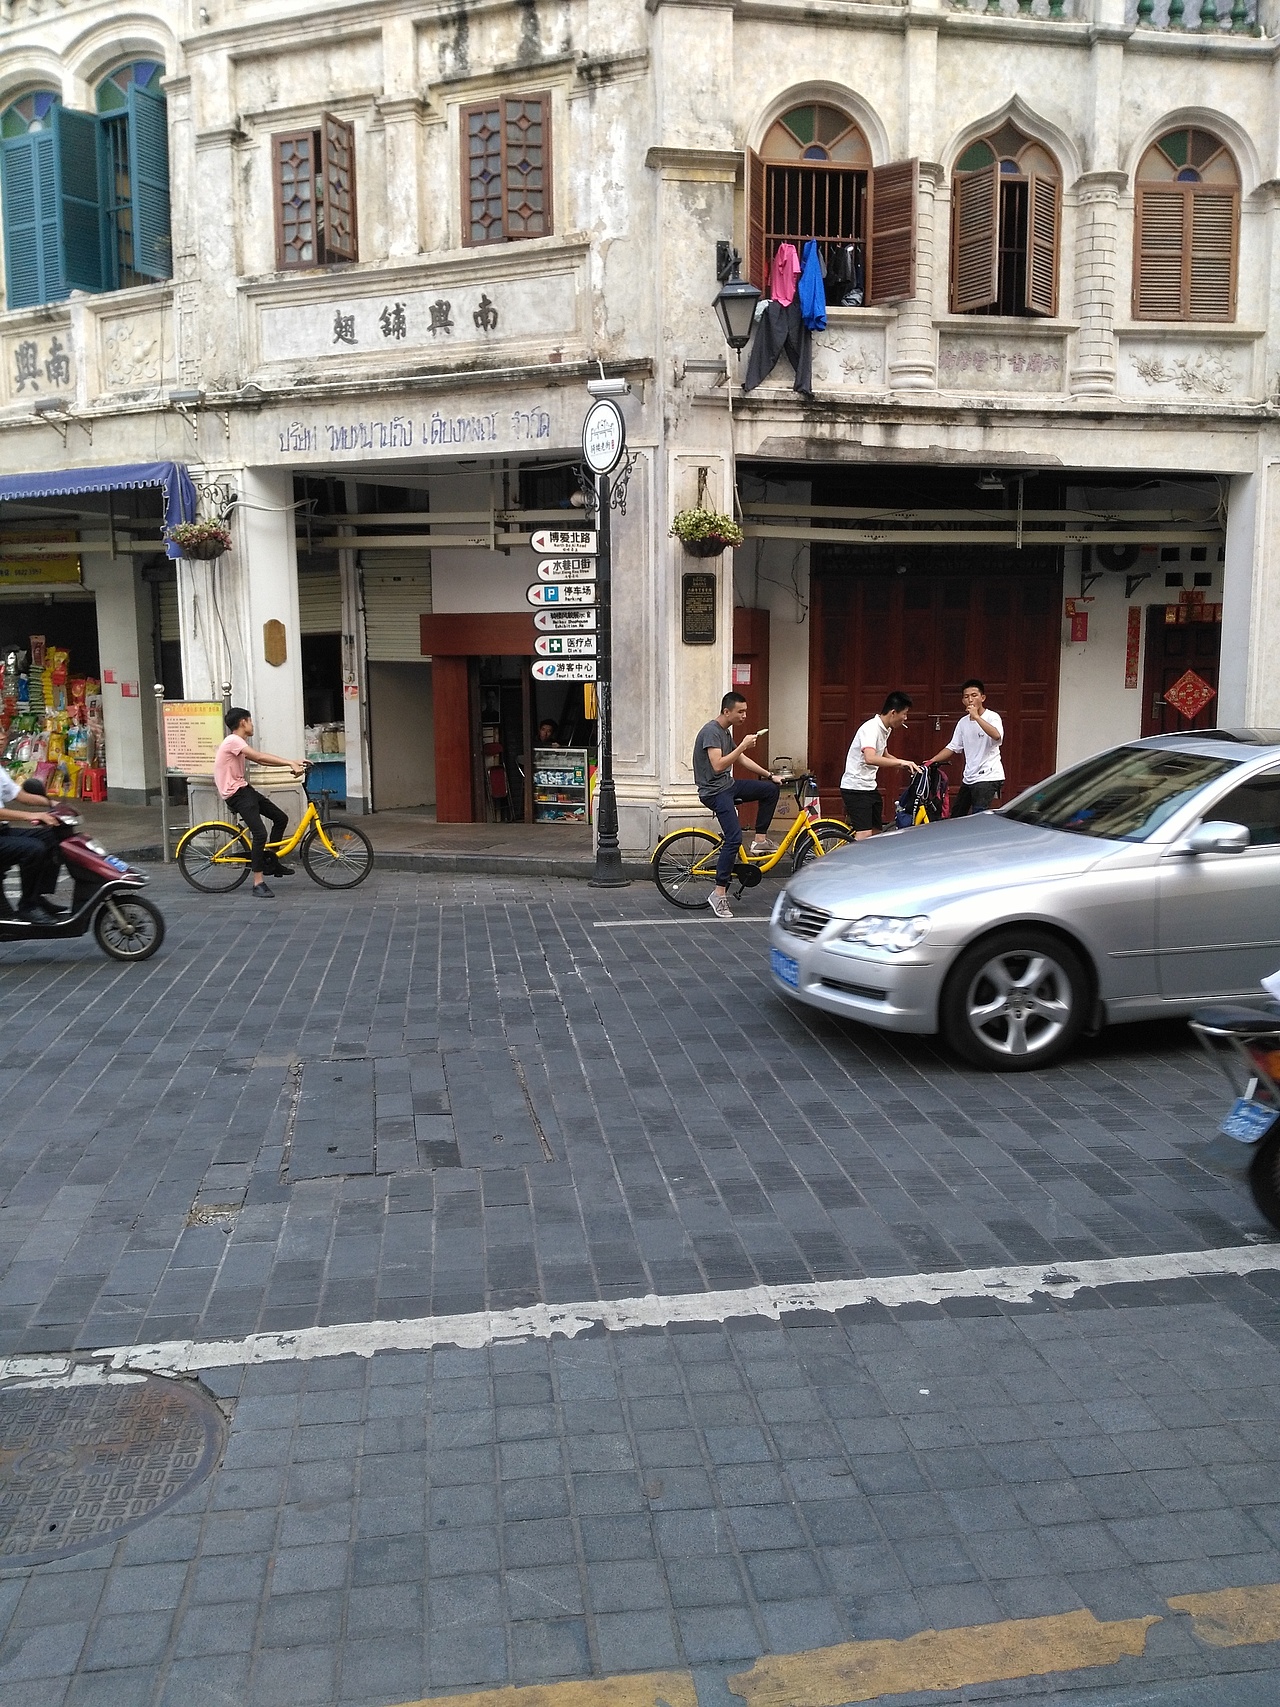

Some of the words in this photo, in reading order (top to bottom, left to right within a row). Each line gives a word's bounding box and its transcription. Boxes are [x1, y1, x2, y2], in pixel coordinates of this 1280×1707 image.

[549, 532, 591, 544] 博爱北路
[553, 559, 591, 571] 水巷口街
[564, 586, 591, 596] 停车场
[567, 638, 592, 647] 医疗点
[557, 663, 592, 672] 游客中心
